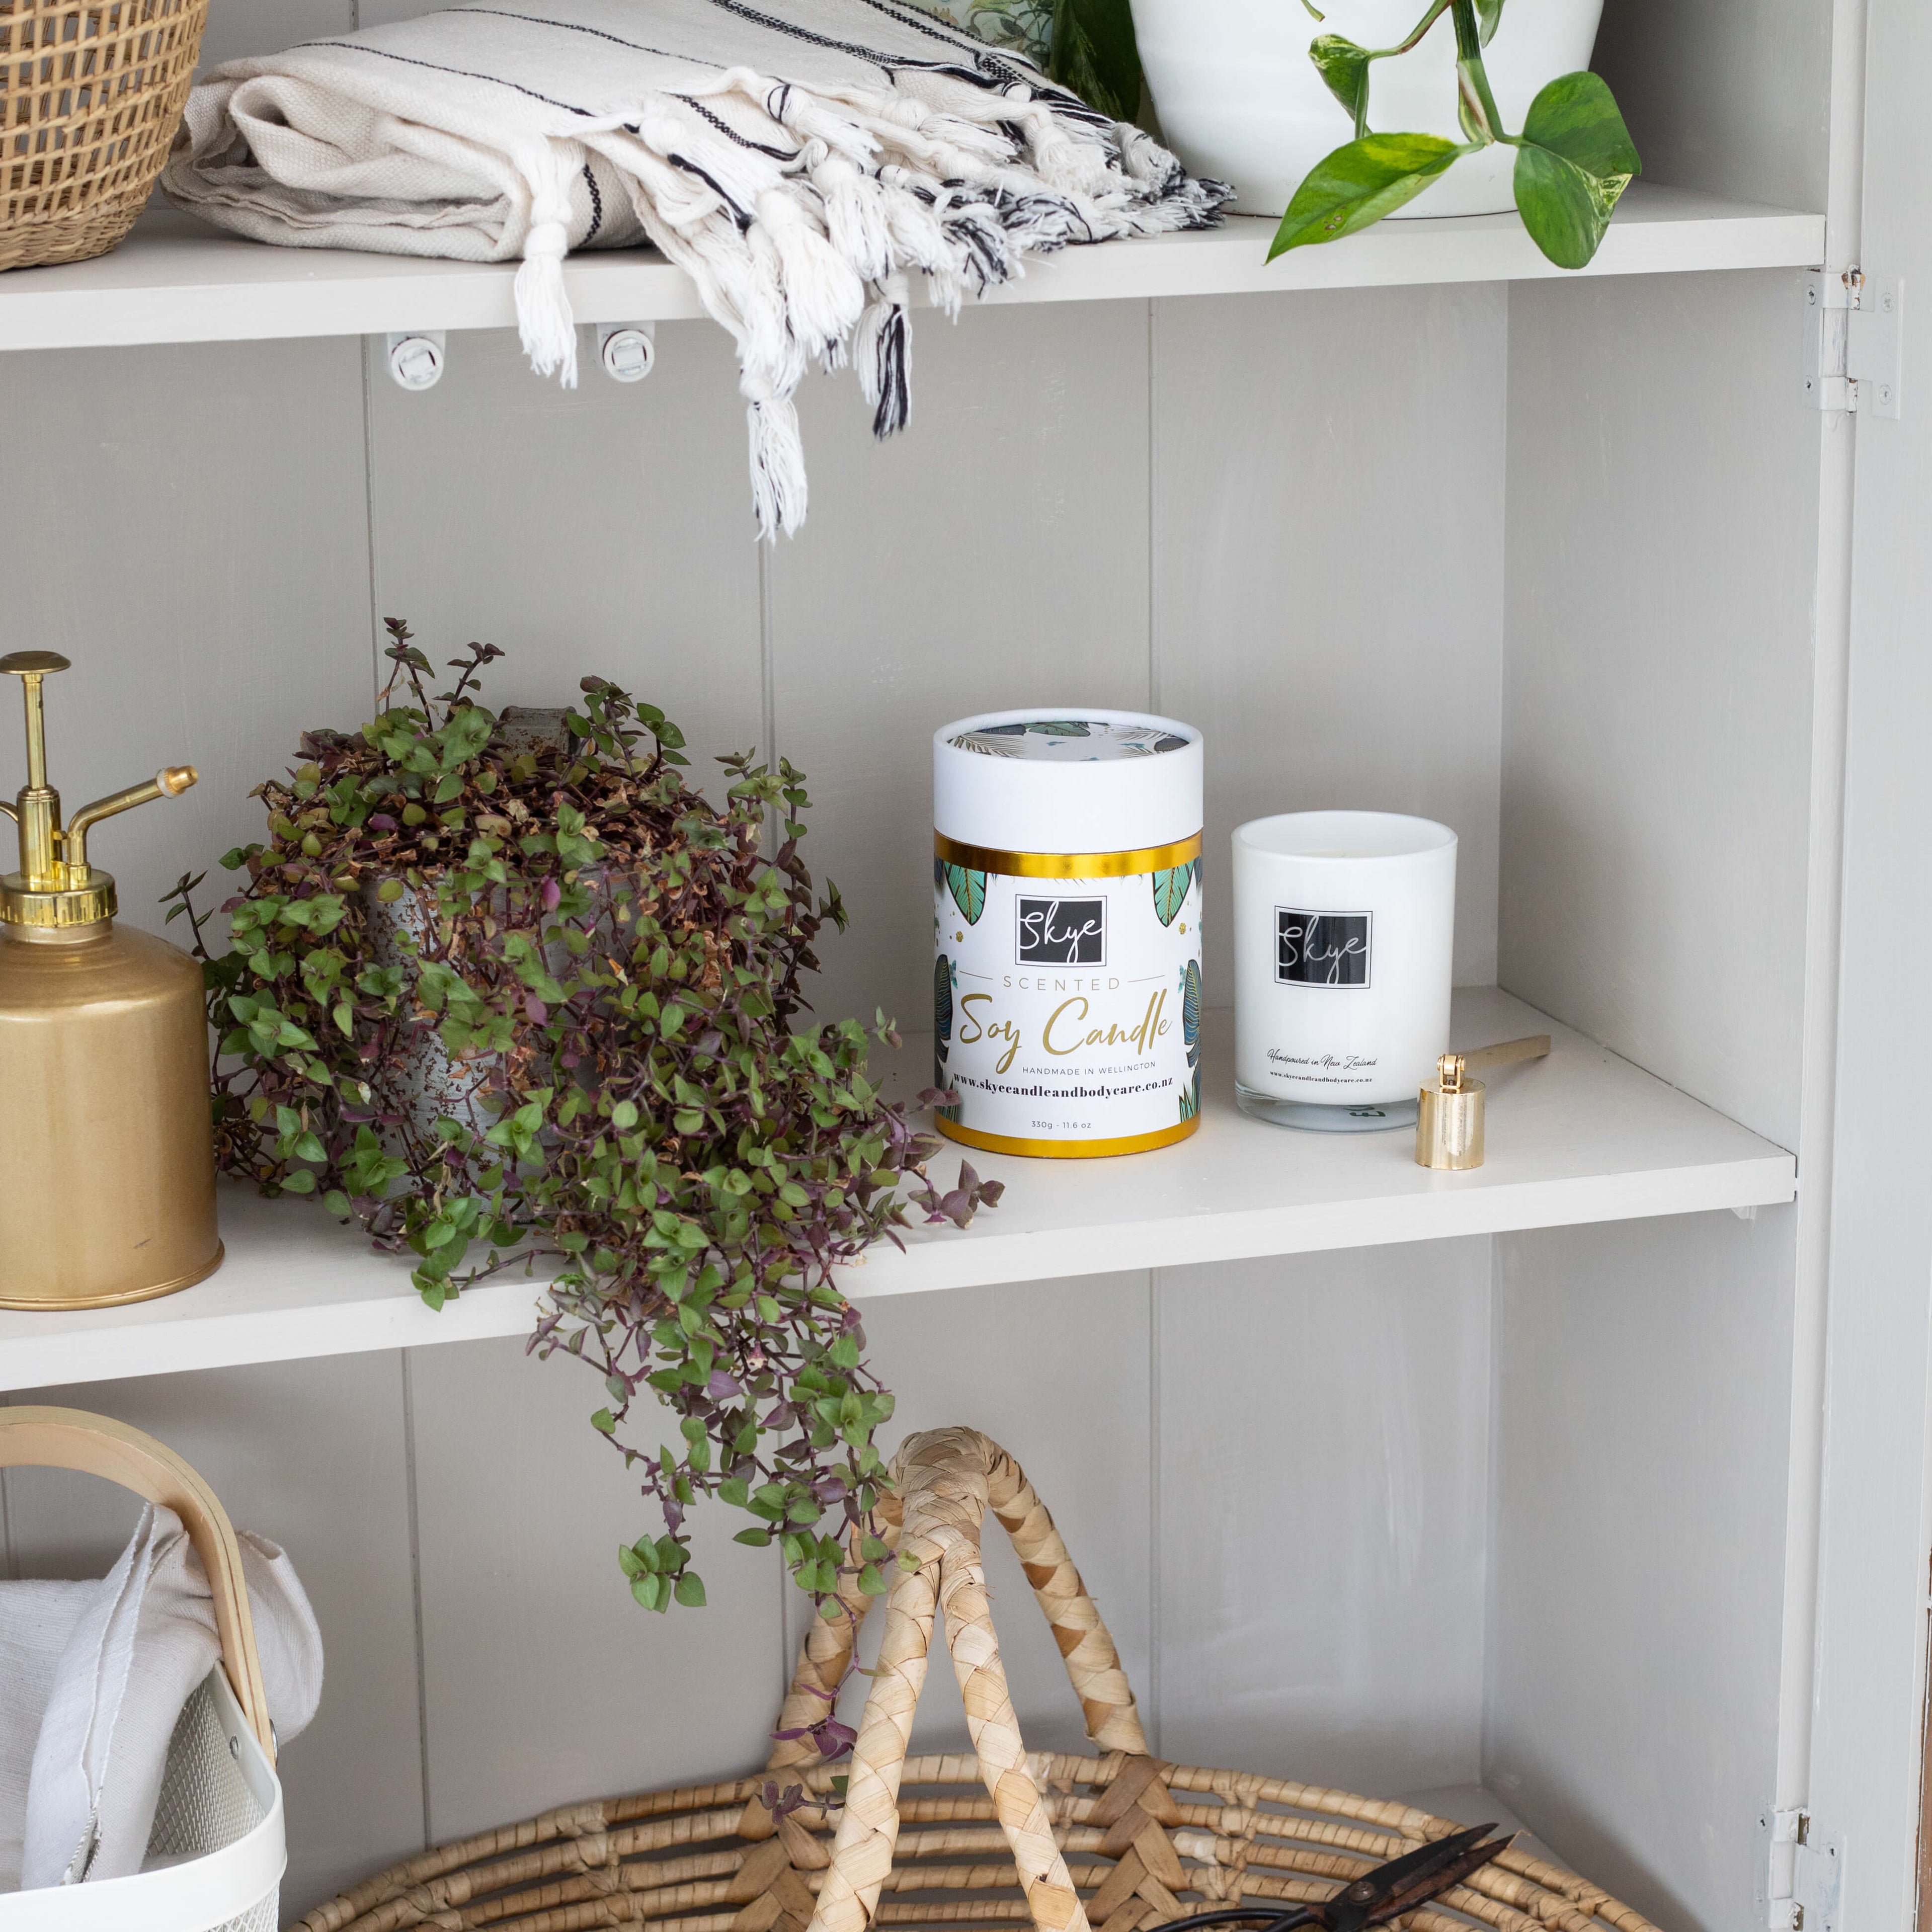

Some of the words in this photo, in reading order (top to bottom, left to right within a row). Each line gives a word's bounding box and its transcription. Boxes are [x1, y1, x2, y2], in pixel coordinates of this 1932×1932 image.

[1020, 900, 1102, 963] Skye
[1279, 914, 1367, 984] Skye
[1003, 976, 1119, 991] SCENTED
[959, 994, 1022, 1074] Soy
[1042, 988, 1173, 1056] Candle
[1023, 1067, 1080, 1075] HANDMADE
[1084, 1066, 1094, 1075] IN
[1098, 1061, 1156, 1074] WELLINGTON
[1267, 1049, 1310, 1065] Handpoured
[1321, 1054, 1341, 1070] New
[1343, 1056, 1377, 1070] Zealand
[953, 1072, 1173, 1099] www.skyecandleandbodycare.co.nz
[1270, 1071, 1373, 1084] www.skyecandleandbodycare.co.nz
[1031, 1120, 1053, 1130] 330g
